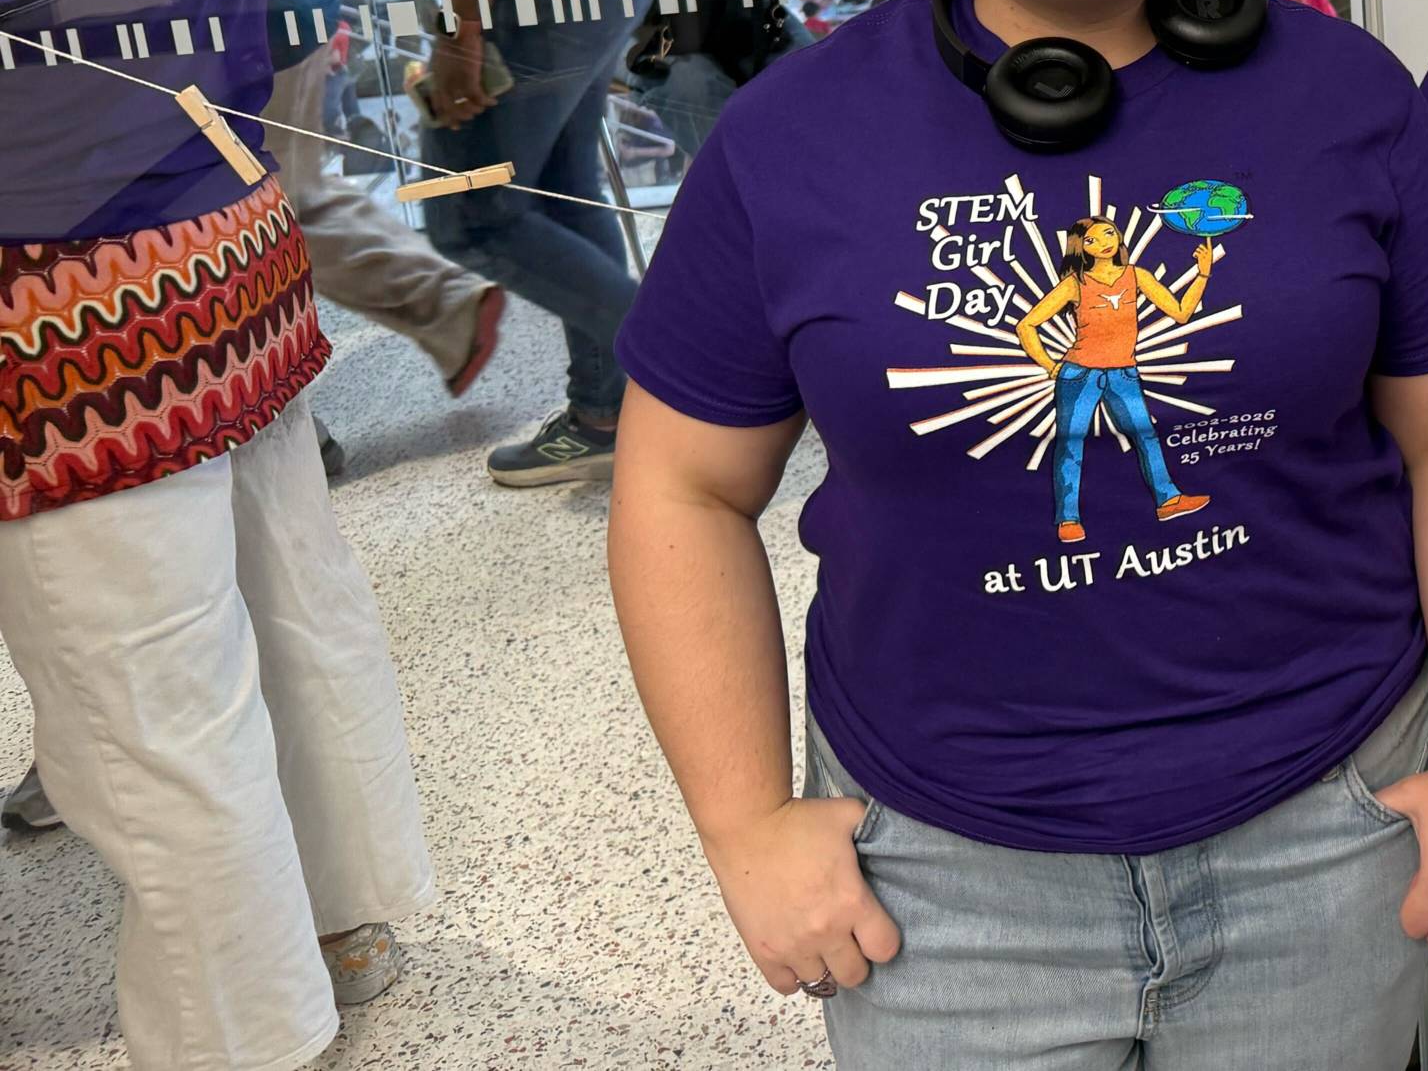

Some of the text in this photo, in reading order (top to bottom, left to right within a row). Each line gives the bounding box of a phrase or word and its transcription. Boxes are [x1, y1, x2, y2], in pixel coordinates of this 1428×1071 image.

[915, 191, 1039, 232] STEM
[931, 224, 1016, 272] Girl
[926, 281, 1016, 327] Day
[1166, 422, 1278, 449] Celebrating
[1172, 409, 1277, 432] 2002-2026
[1179, 438, 1261, 465] 25 Years!
[983, 525, 1250, 594] at UT Austin
